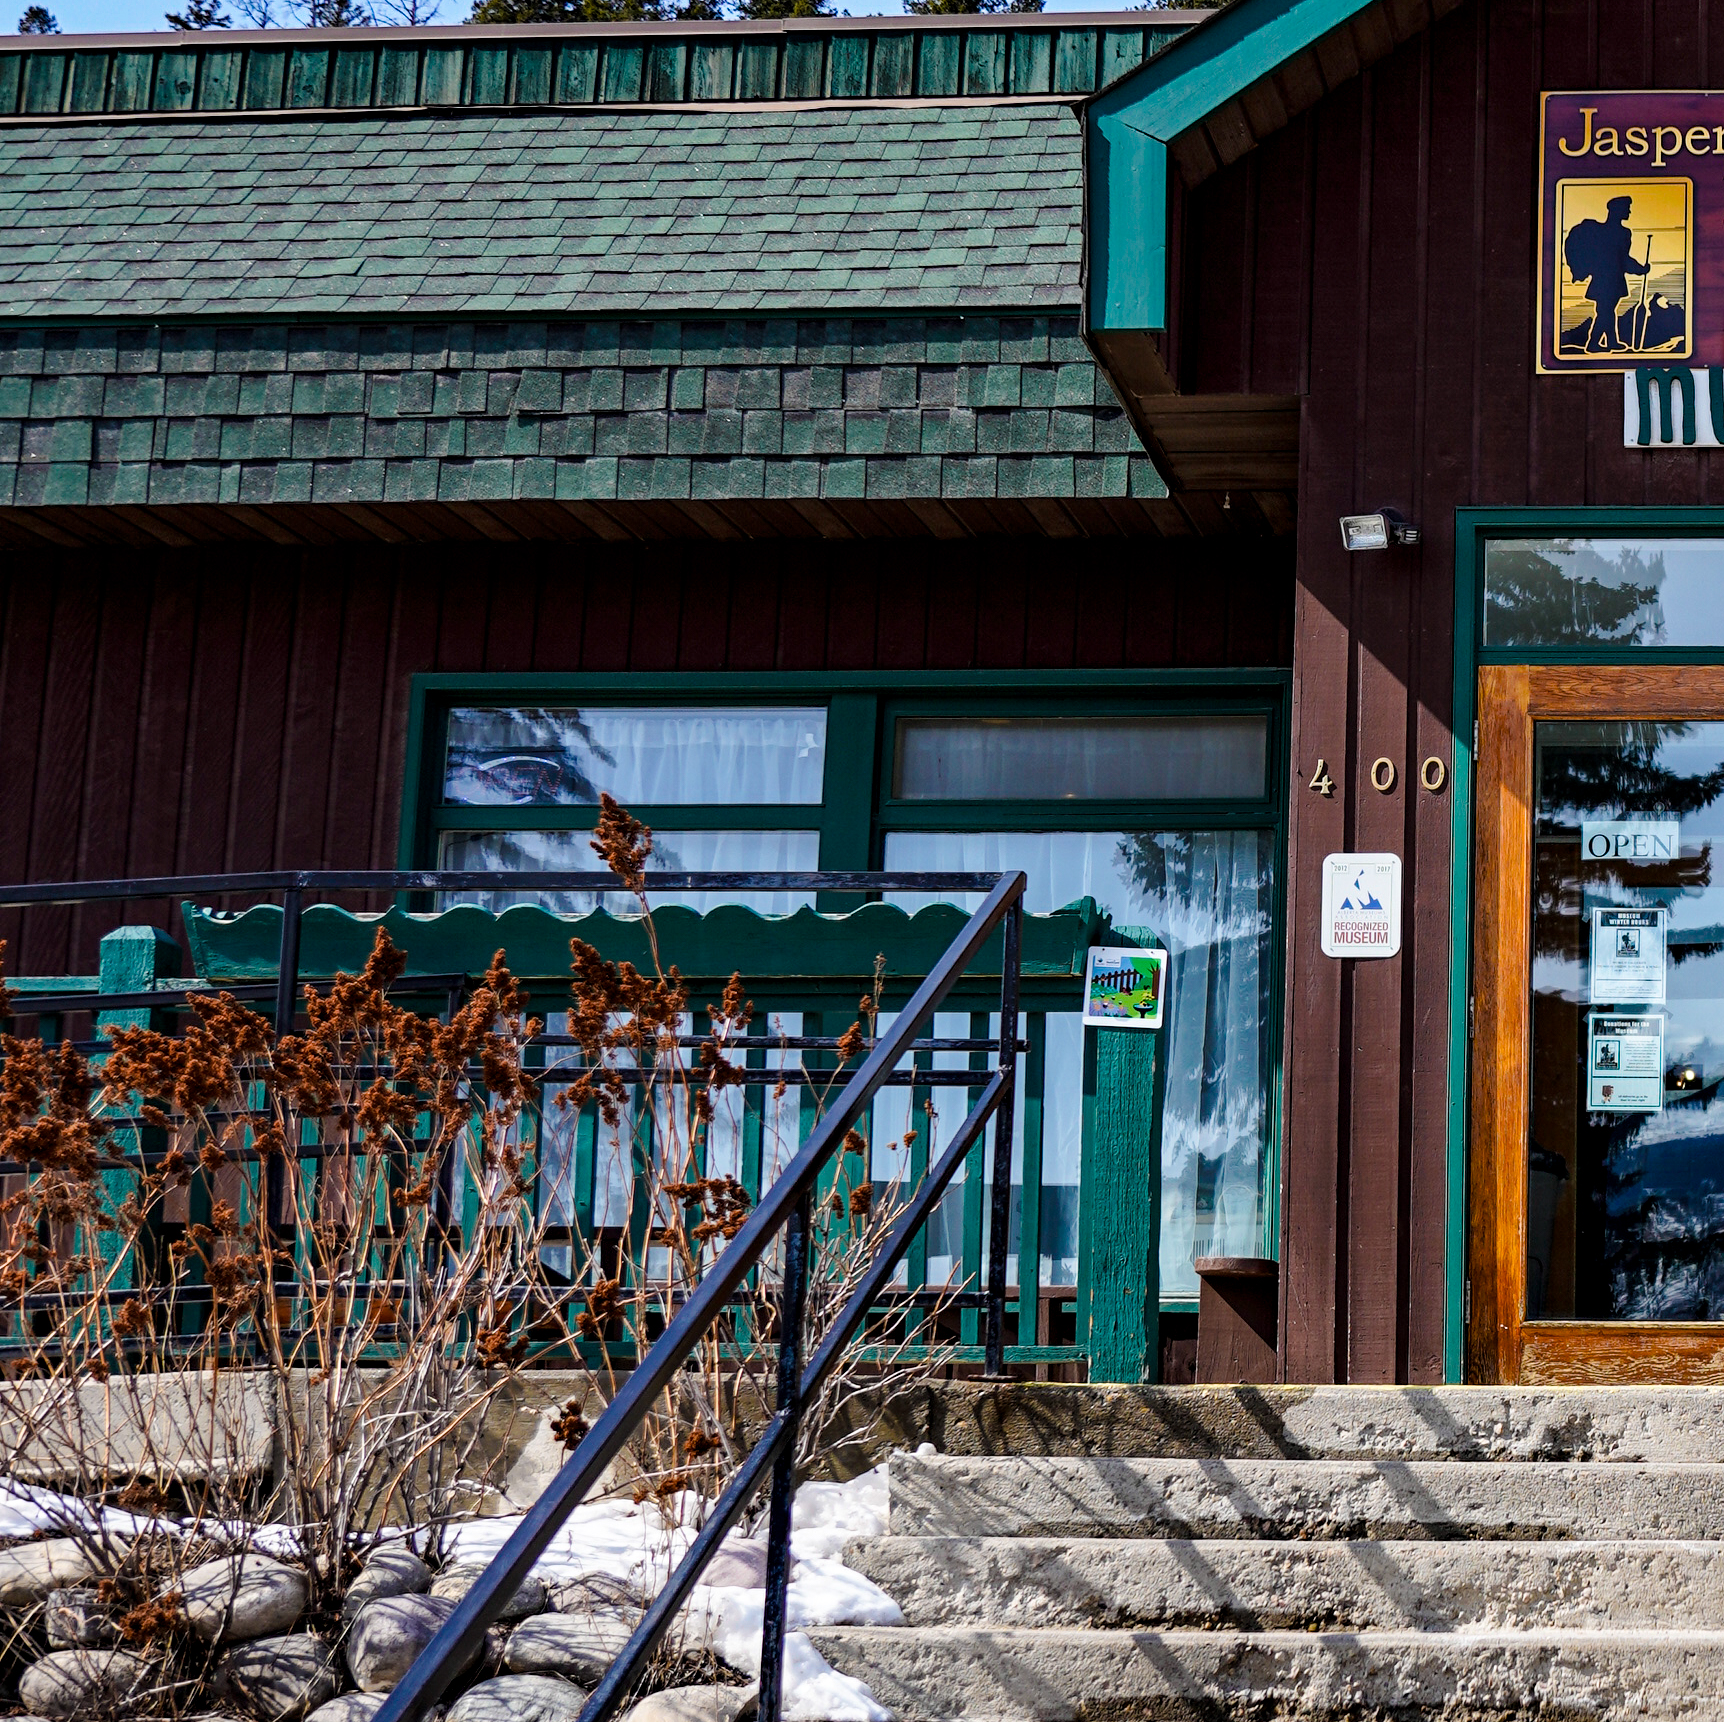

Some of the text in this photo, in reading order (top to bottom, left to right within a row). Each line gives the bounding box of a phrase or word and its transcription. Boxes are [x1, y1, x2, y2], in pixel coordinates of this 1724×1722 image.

[1588, 833, 1675, 858] OPEN
[1334, 921, 1389, 931] RECOGNIZED
[1334, 931, 1388, 944] MUSEUM
